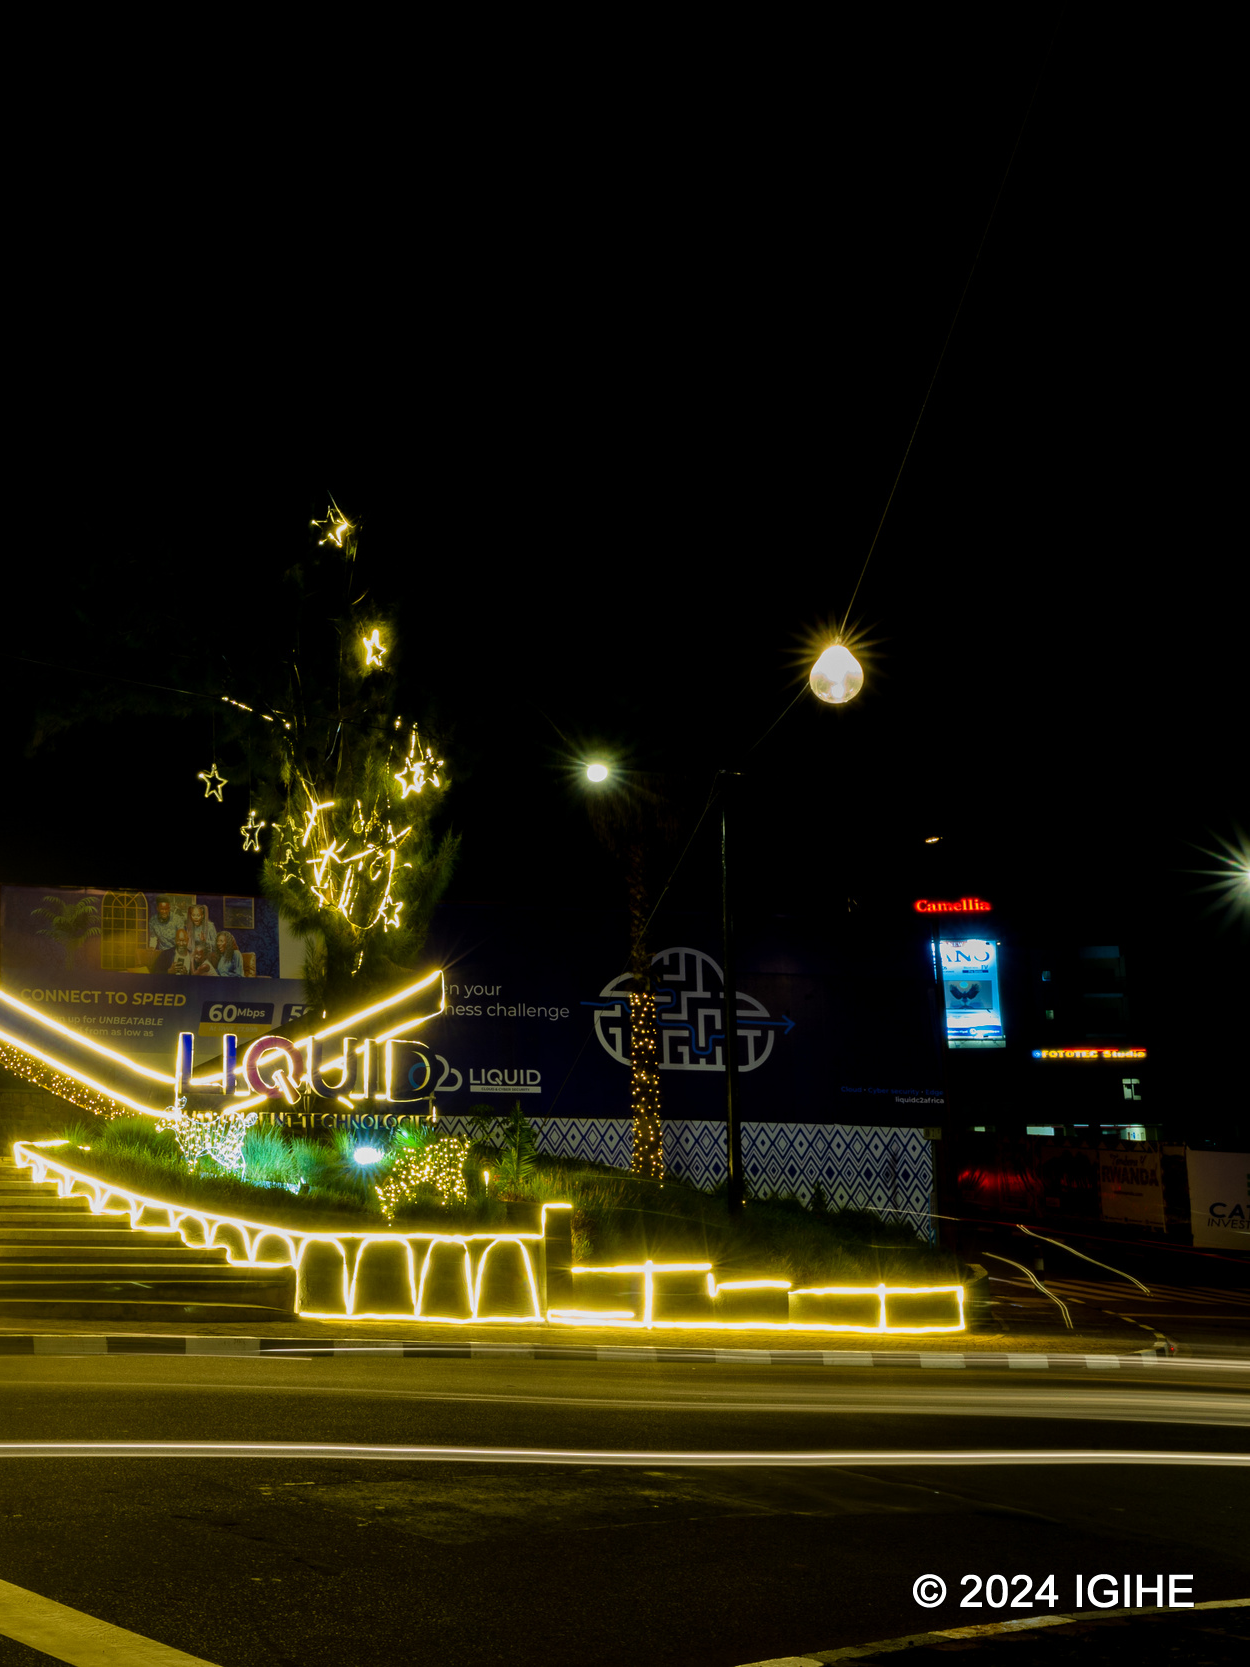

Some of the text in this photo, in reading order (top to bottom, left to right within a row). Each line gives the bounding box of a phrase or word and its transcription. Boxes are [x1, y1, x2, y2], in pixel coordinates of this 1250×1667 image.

[914, 898, 992, 912] Camellia
[20, 988, 187, 1007] CONNECT TO SPEED
[463, 984, 503, 999] your
[444, 1002, 571, 1022] ness challenge
[68, 1016, 81, 1027] up
[83, 1015, 97, 1025] for
[98, 1016, 164, 1026] UNBEATABLE
[85, 1026, 109, 1037] from
[110, 1028, 122, 1037] as
[123, 1027, 141, 1038] low
[143, 1029, 154, 1038] as
[175, 1031, 438, 1105] LIQUID
[469, 1068, 542, 1086] LIQUID
[840, 1085, 863, 1094] Cloud
[867, 1086, 890, 1096] Cyber
[891, 1087, 920, 1097] security
[1101, 1165, 1160, 1187] RWANDA
